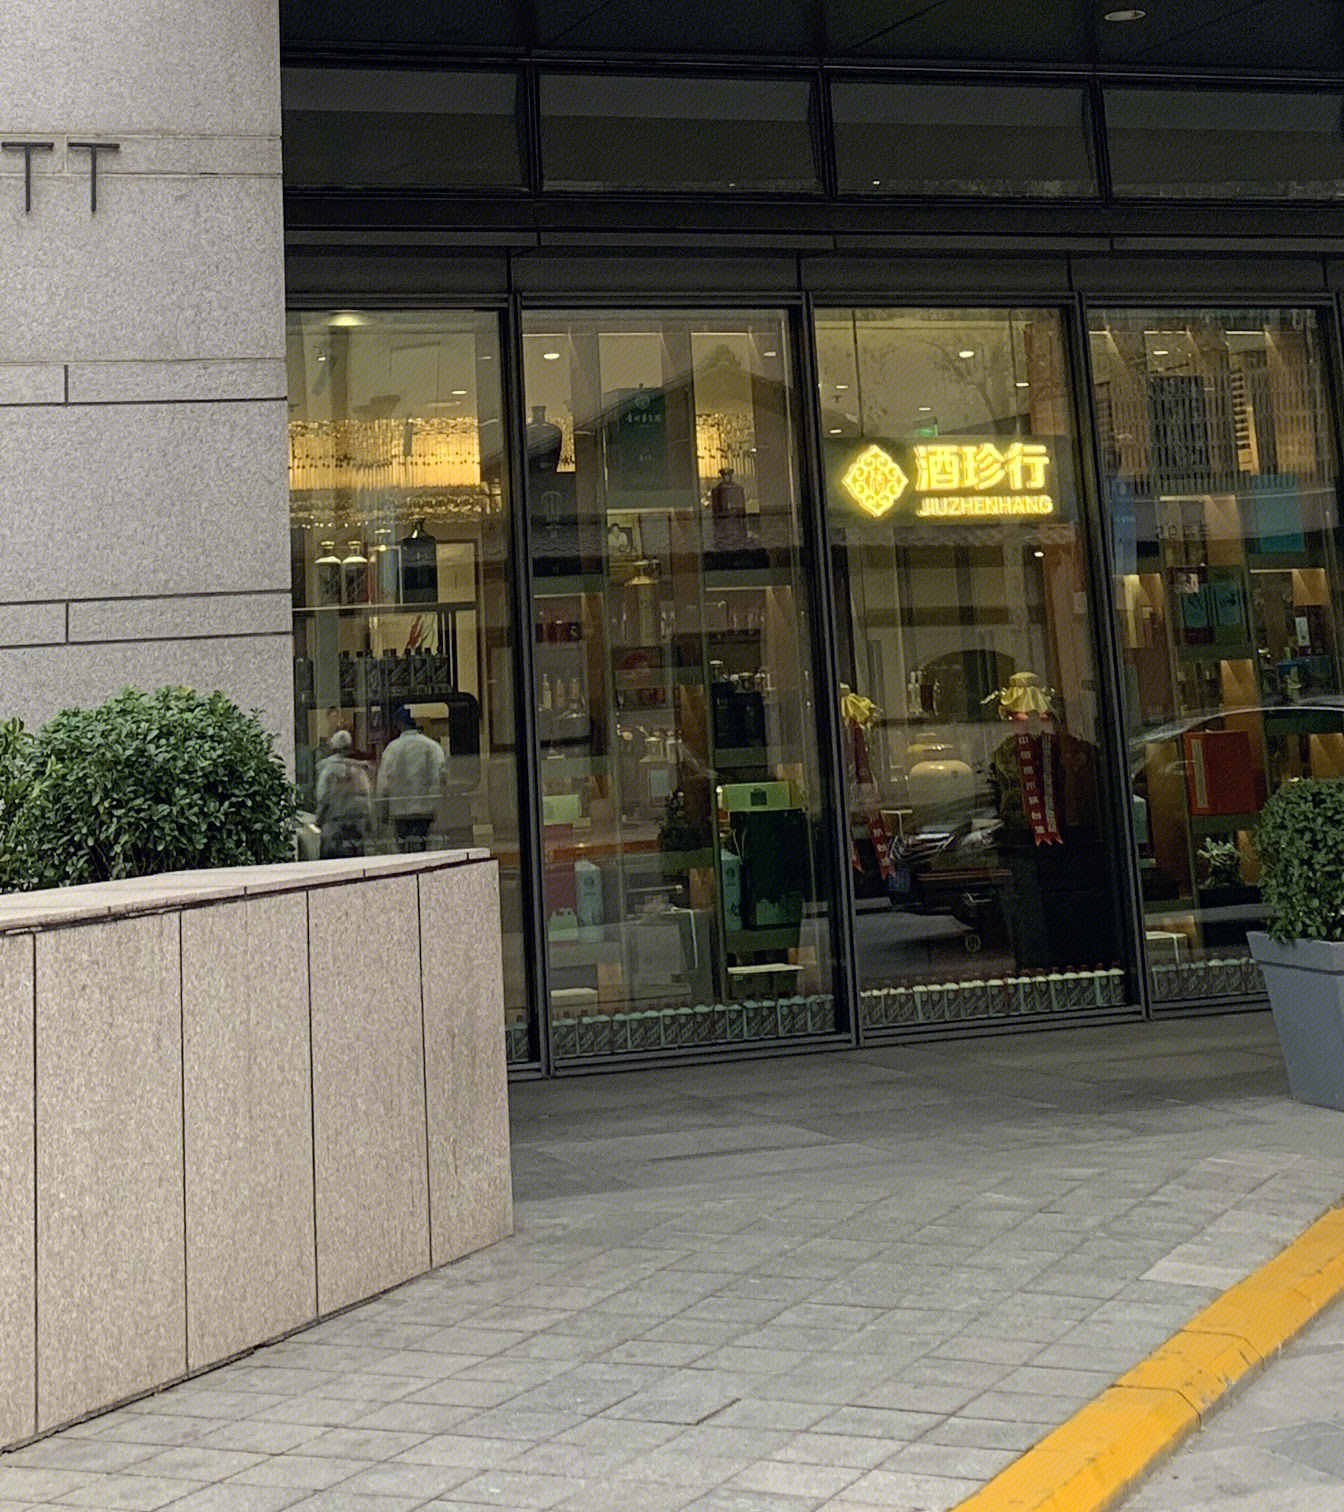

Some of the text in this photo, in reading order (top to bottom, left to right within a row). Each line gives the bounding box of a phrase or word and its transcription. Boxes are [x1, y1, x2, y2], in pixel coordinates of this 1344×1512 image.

[914, 442, 1050, 491] 酒珍行
[916, 494, 1054, 517] JIUZHENHANG
